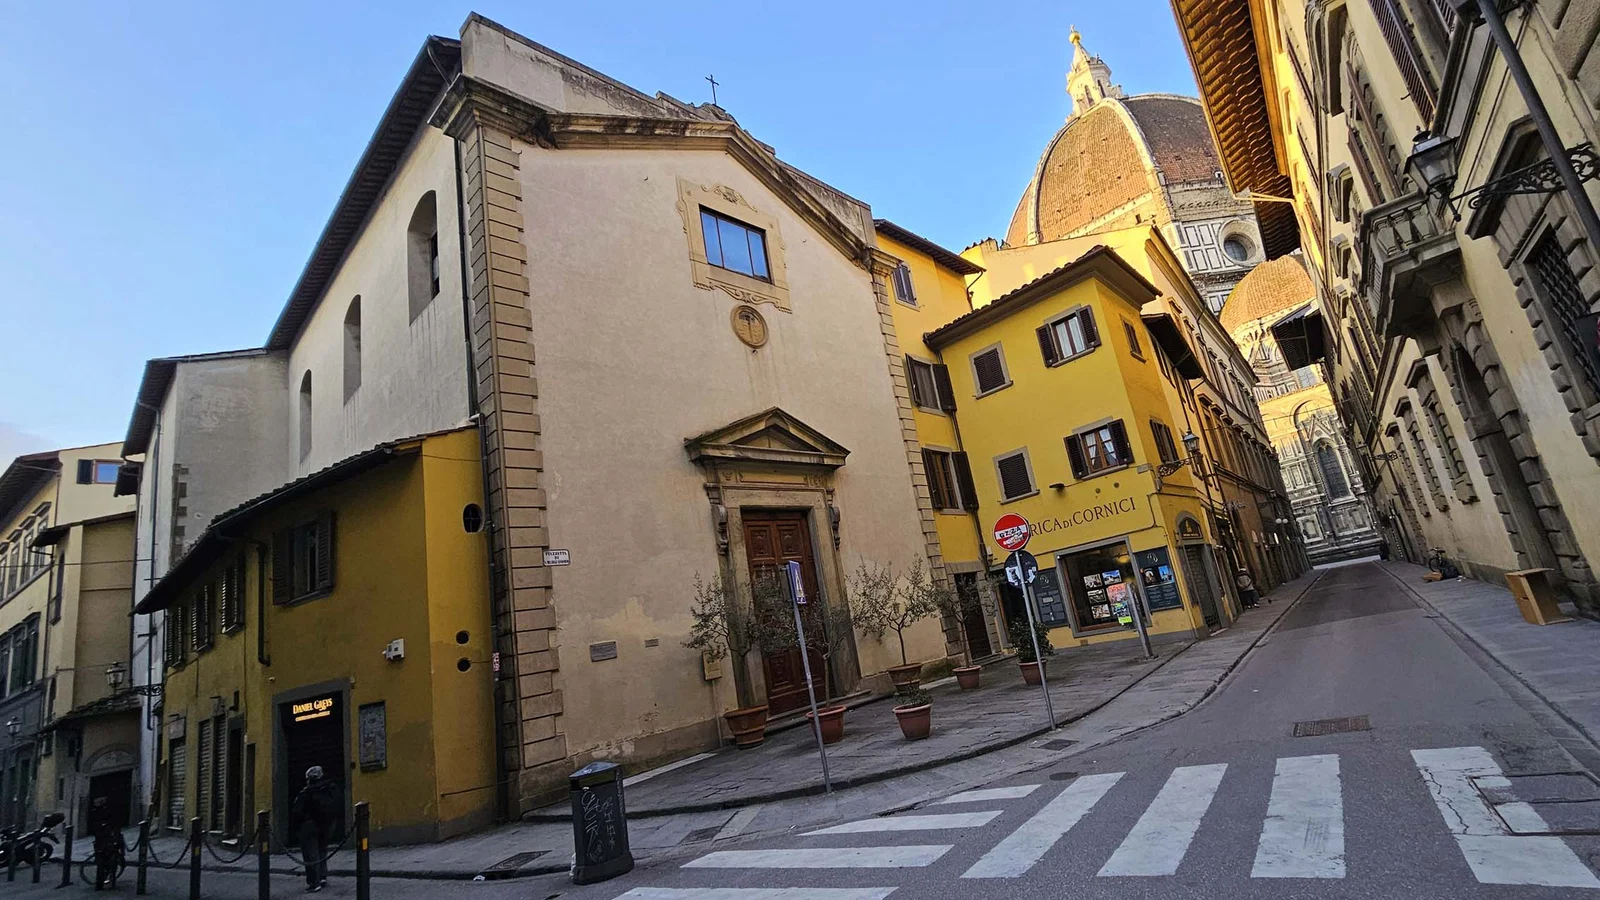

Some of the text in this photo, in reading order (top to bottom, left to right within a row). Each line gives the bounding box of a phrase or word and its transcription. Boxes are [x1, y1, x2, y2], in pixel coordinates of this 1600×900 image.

[1063, 519, 1073, 528] DI
[1073, 497, 1136, 525] CORNICI
[293, 702, 313, 714] DANIEL
